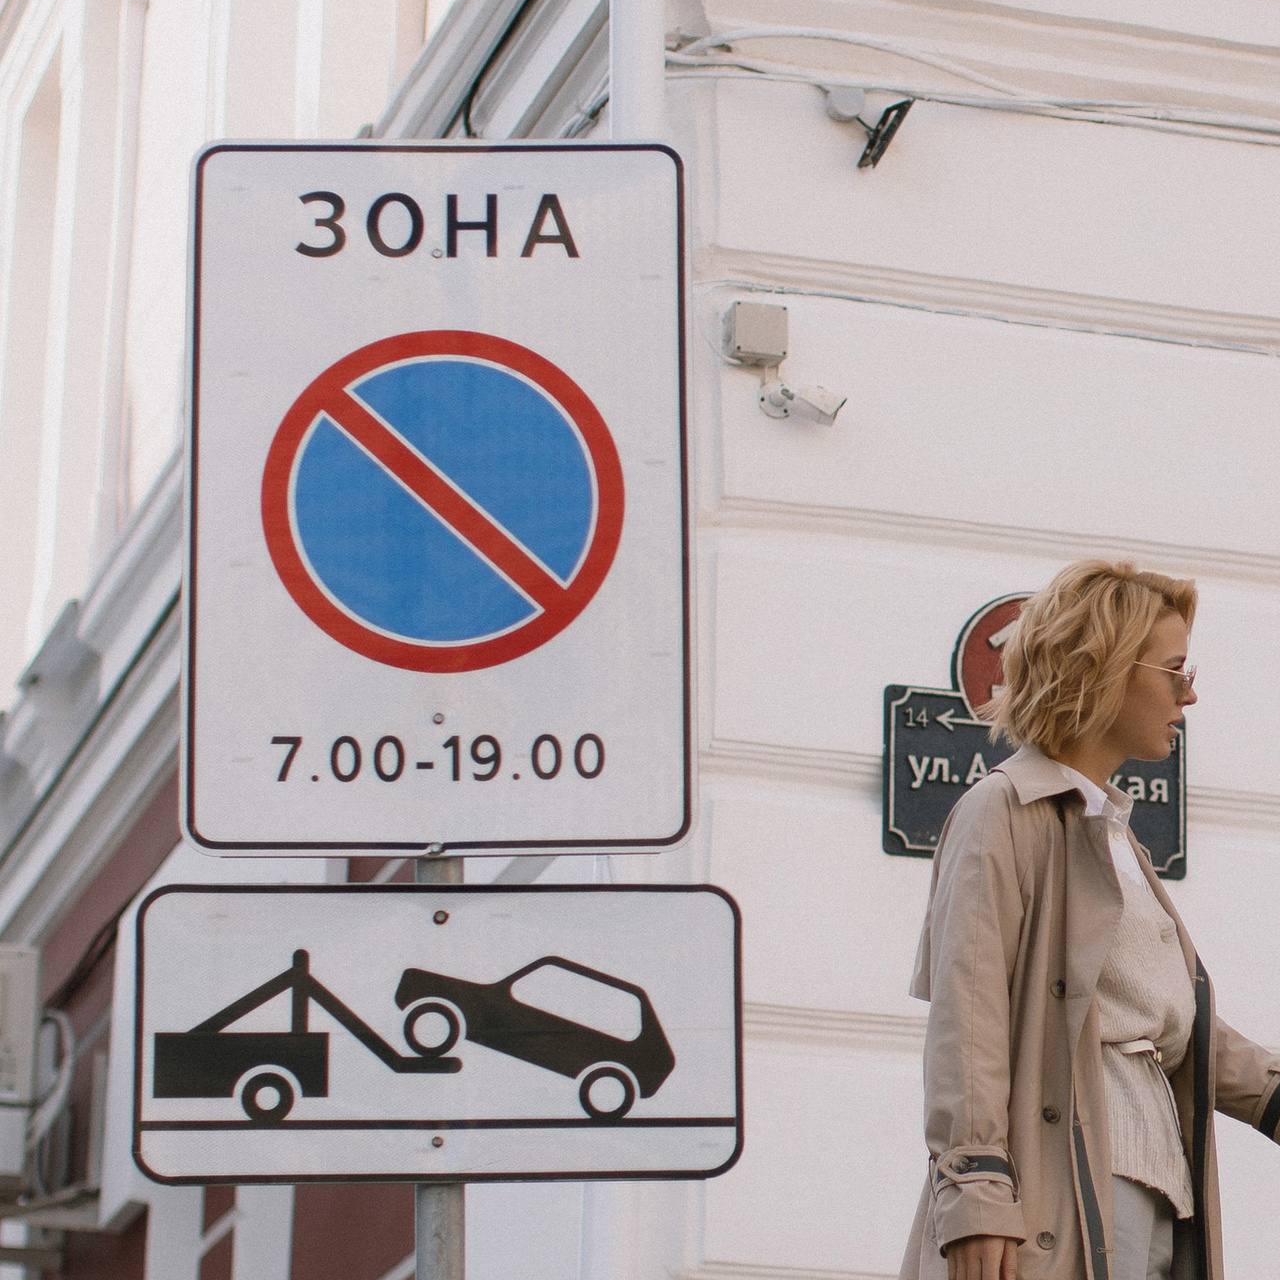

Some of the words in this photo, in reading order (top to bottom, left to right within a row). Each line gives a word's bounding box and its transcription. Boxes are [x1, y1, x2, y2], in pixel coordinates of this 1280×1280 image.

[294, 191, 580, 258] ЗОНА
[905, 707, 929, 728] 14
[270, 733, 606, 783] 7.00-19.00
